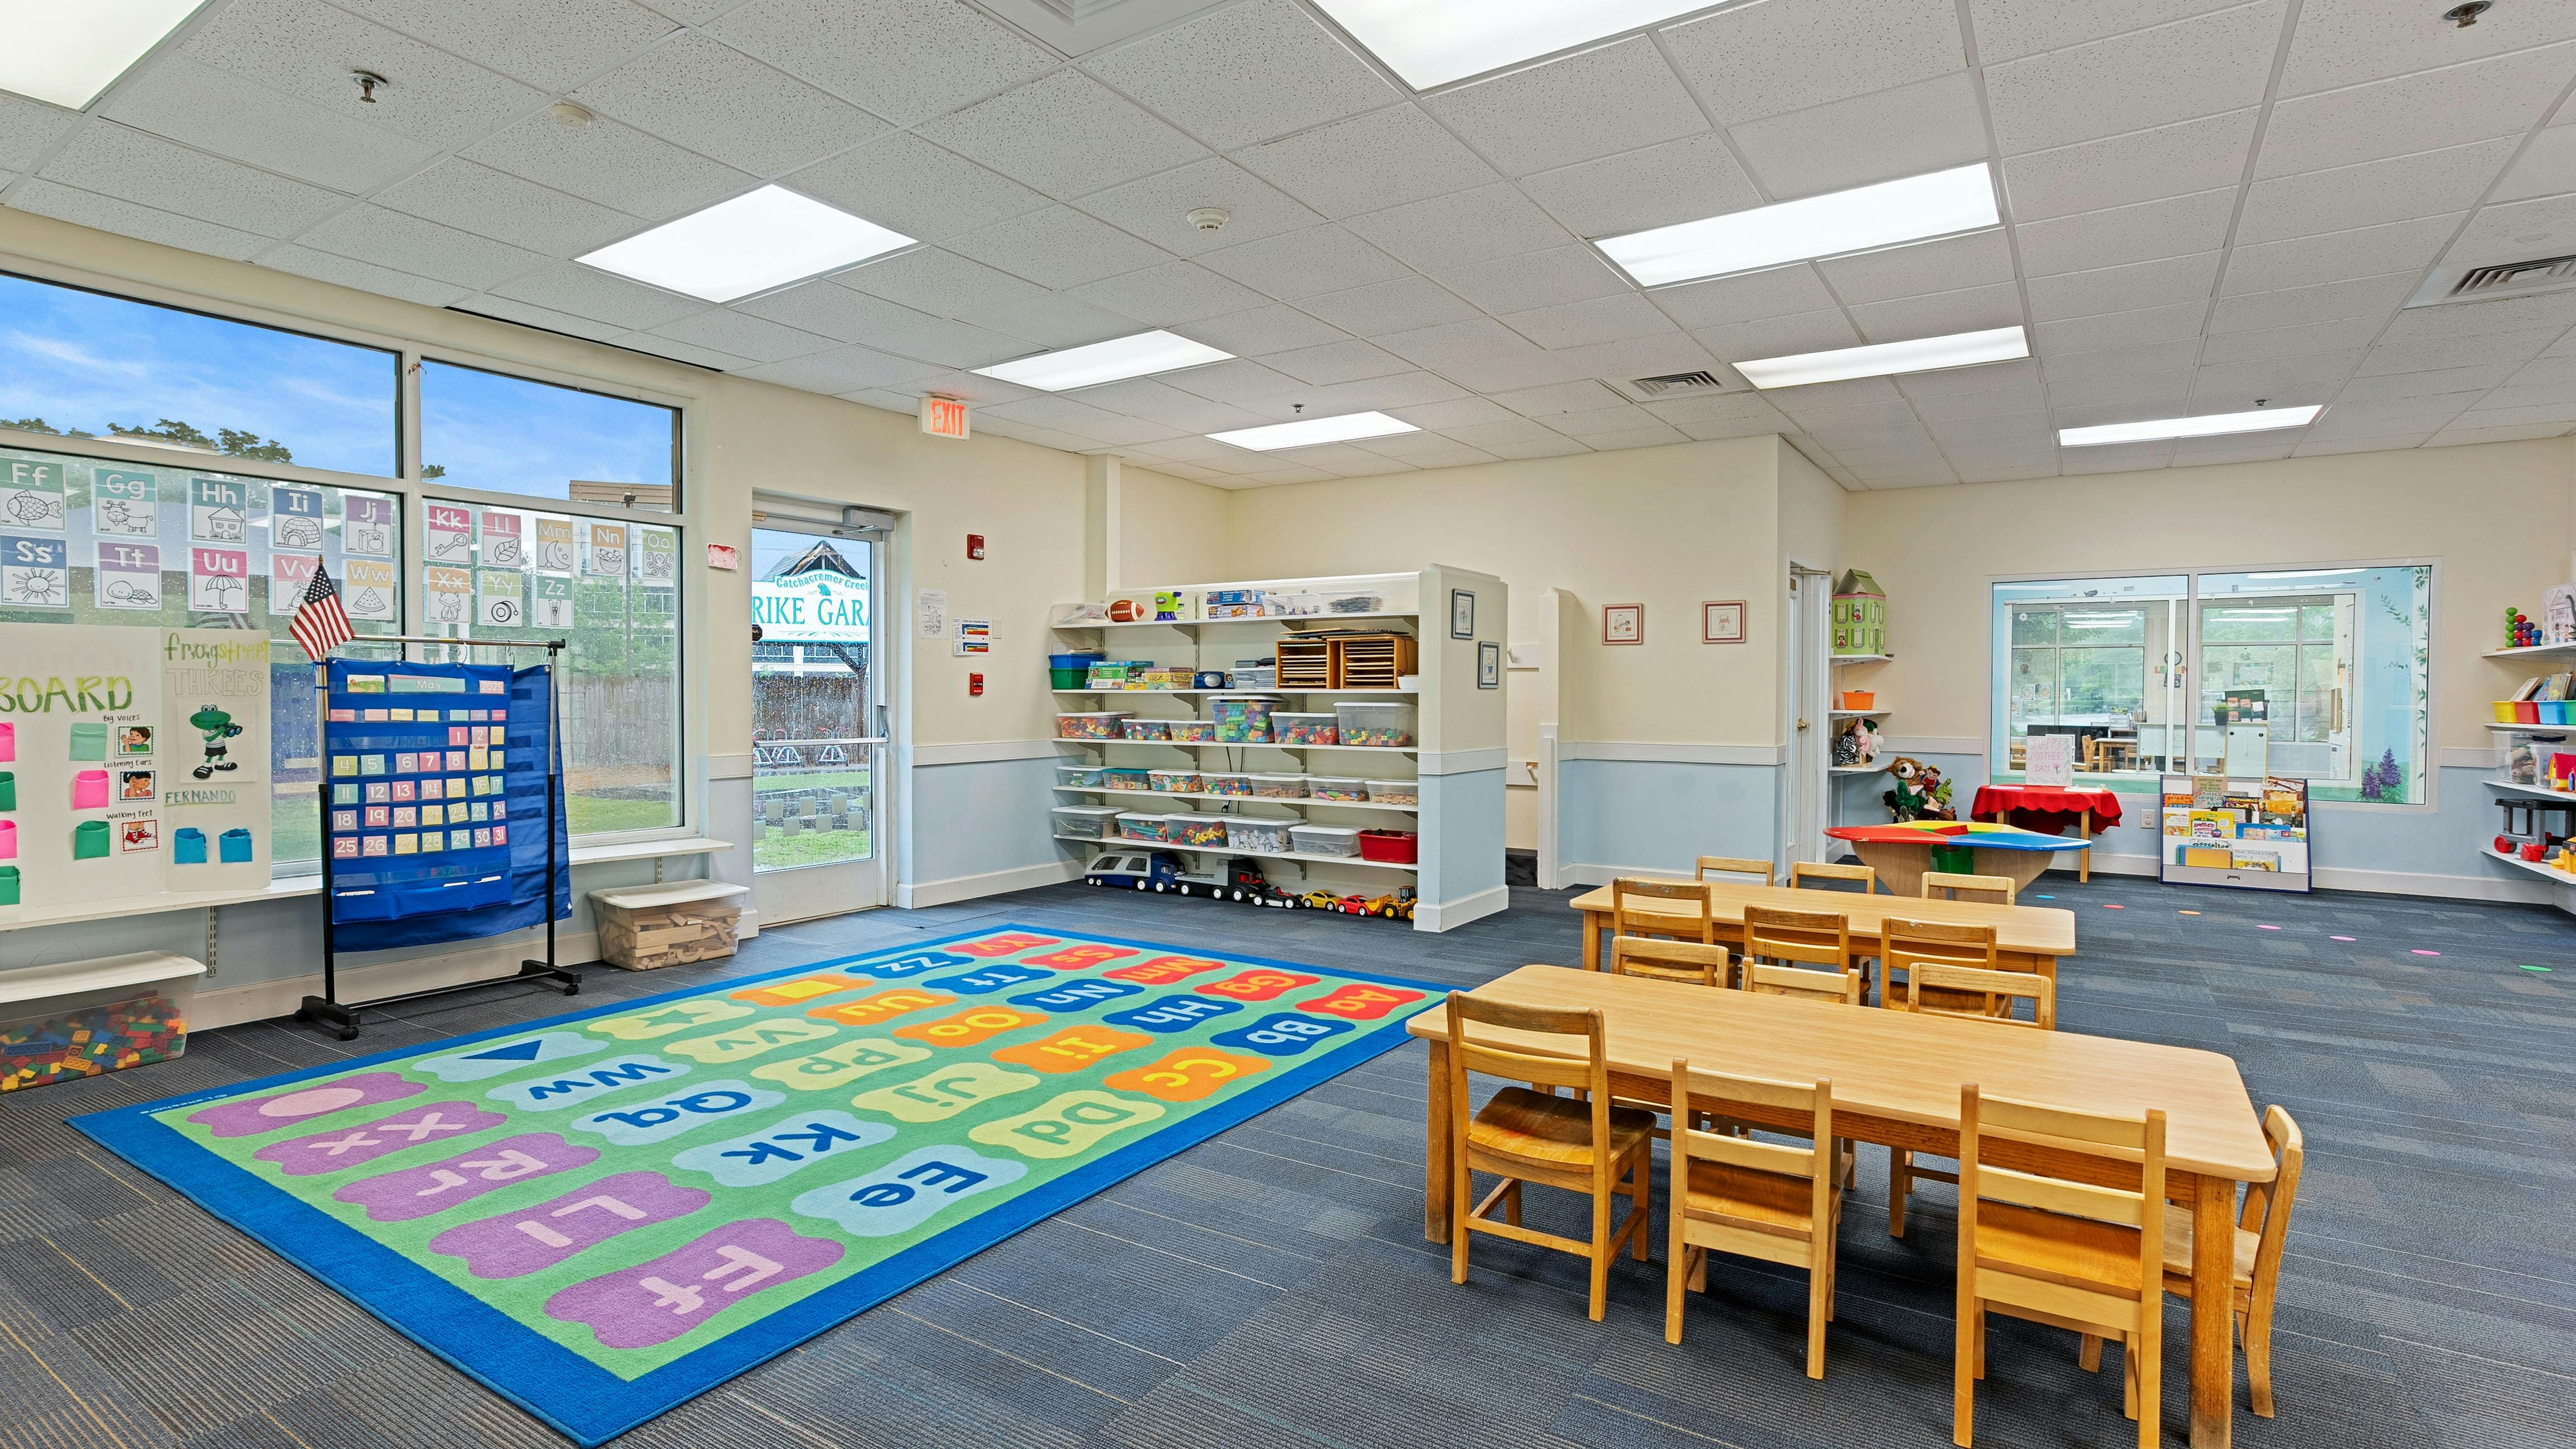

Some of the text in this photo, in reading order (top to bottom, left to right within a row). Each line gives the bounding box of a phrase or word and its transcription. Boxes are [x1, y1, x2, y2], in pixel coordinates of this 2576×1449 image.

[931, 400, 964, 435] EXIT
[11, 463, 49, 486] Ff
[105, 474, 146, 500] Gg
[201, 482, 236, 505] Hh
[288, 492, 308, 513] Ii
[360, 501, 377, 523] Jj
[436, 509, 463, 528] Kk
[494, 517, 509, 533] Ll
[538, 522, 571, 538] Mm
[596, 528, 620, 544] Nn
[647, 533, 670, 548] Oo
[16, 541, 53, 564] Ss
[115, 547, 145, 567] Tt
[203, 552, 238, 573] Uu
[280, 558, 316, 578] Vv
[349, 563, 390, 582] Ww
[436, 571, 463, 588] Xx
[490, 576, 513, 595] Yy
[545, 580, 565, 595] Zz
[818, 598, 869, 626] GAR
[165, 668, 264, 698] THREES
[416, 680, 502, 692] May 2025
[457, 730, 501, 743] 1 2 3
[103, 760, 134, 769] Listening
[340, 754, 501, 771] 4 5 6 7 8 9 10
[2035, 764, 2049, 773] DAY
[165, 789, 237, 804] FERNANDO
[342, 779, 500, 799] 11 12 13 14 15 16 17
[106, 811, 136, 820] Walking
[338, 804, 505, 826] 18 19 20 21 22 23 24
[335, 830, 504, 853] 25 26 27 28 29 30 31
[972, 938, 1041, 951] Yy
[875, 958, 951, 972] Zz
[1052, 950, 1114, 963] Ss
[962, 973, 1028, 986] Tt
[1120, 959, 1213, 979] Mm
[1035, 984, 1124, 1004] Nn
[1214, 976, 1296, 993] Gg
[837, 996, 934, 1016] Uu
[1324, 989, 1400, 1011] Aa
[1131, 1000, 1224, 1023] Hh
[927, 1014, 1021, 1036] Oo
[1247, 1020, 1332, 1044] Bb
[714, 1030, 808, 1050] Vv
[1040, 1037, 1117, 1059] Ii
[798, 1048, 901, 1074] Pp
[528, 1063, 671, 1100] Ww
[1142, 1059, 1237, 1087] Cc
[892, 1077, 977, 1107] Jj
[593, 1091, 751, 1128] Qq
[1011, 1101, 1135, 1145] Dd
[308, 1112, 467, 1156] Xx
[721, 1123, 861, 1165] Kk
[416, 1149, 549, 1197] Rr
[849, 1161, 988, 1208] Ee
[514, 1195, 647, 1248] Ll
[638, 1244, 784, 1315] Ff
